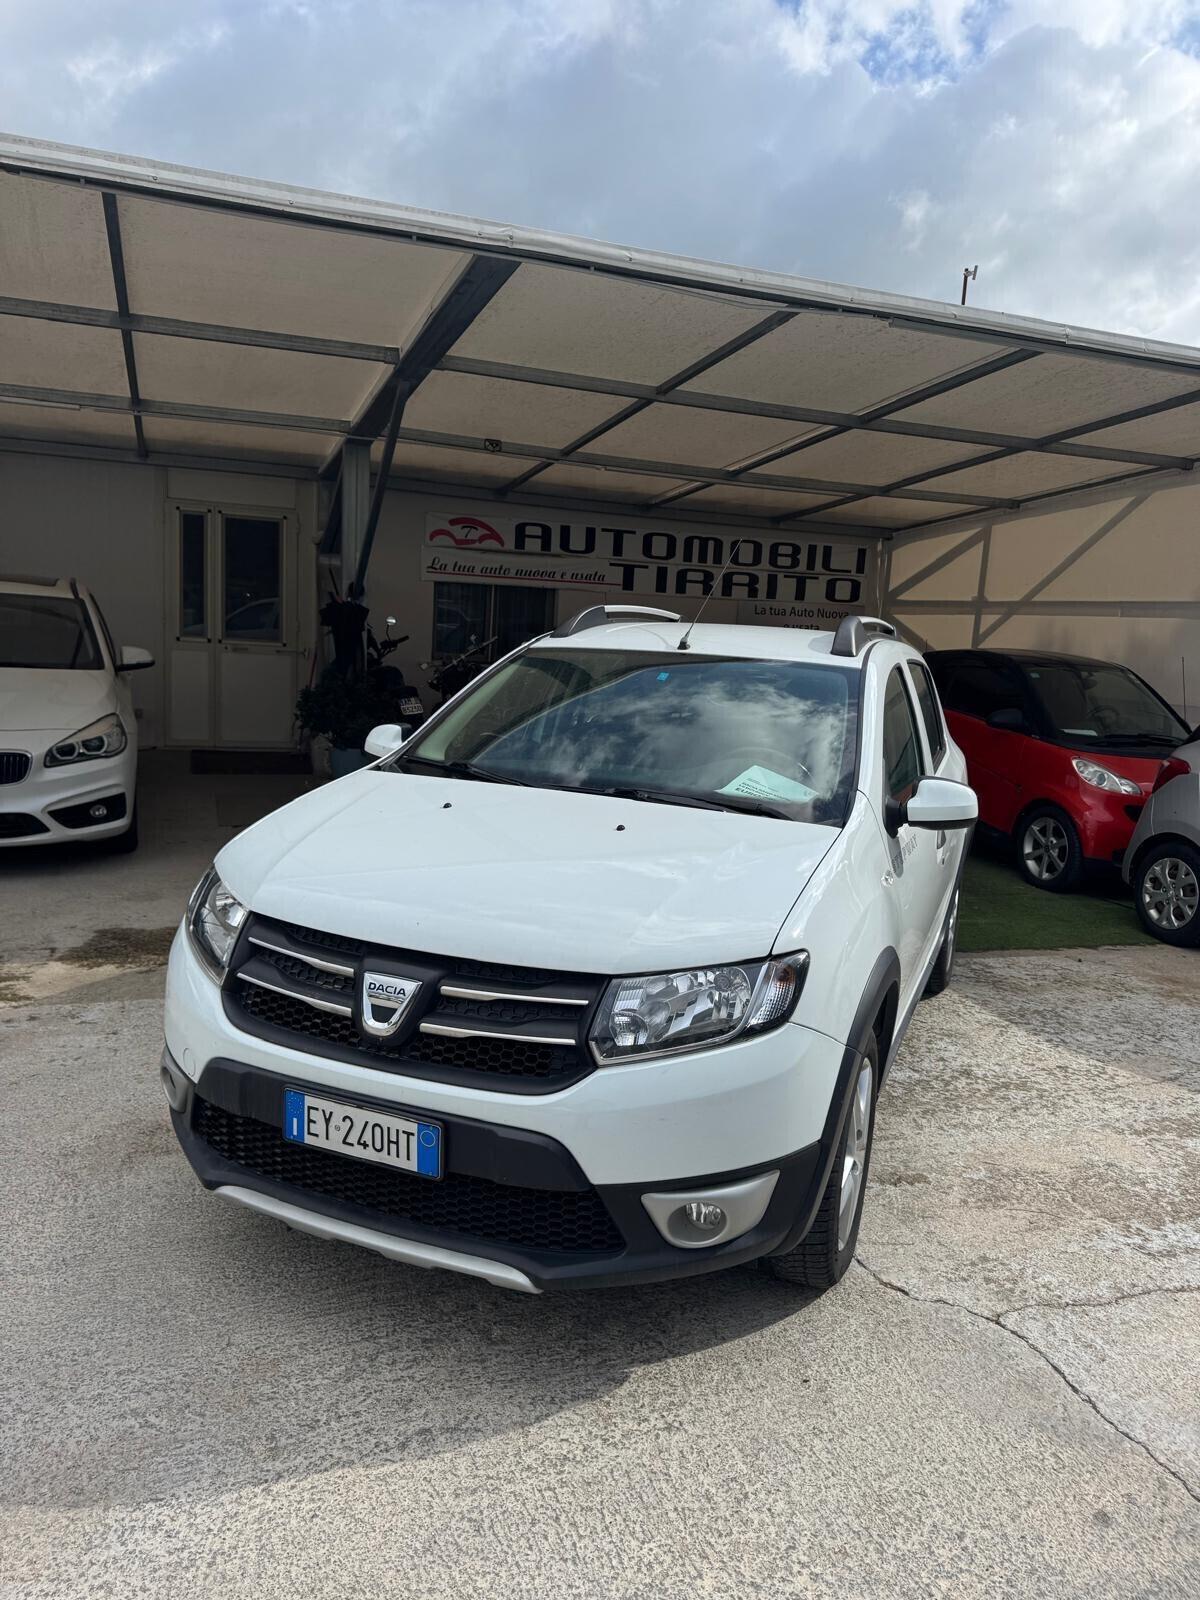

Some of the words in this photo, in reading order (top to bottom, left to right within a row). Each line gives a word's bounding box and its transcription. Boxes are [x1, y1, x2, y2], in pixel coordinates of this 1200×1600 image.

[514, 522, 867, 574] AUTOMOBILI
[427, 556, 448, 572] La
[452, 561, 475, 573] tua
[480, 563, 511, 576] auto
[515, 569, 555, 579] nuova
[571, 569, 606, 582] usata
[609, 562, 862, 603] TIRRITO
[754, 605, 766, 616] La
[769, 607, 786, 617] tua
[789, 607, 814, 618] Auto
[817, 608, 849, 619] Nuova
[368, 981, 406, 997] DACIA
[307, 1105, 333, 1141] EY
[342, 1115, 415, 1161] 240HT
